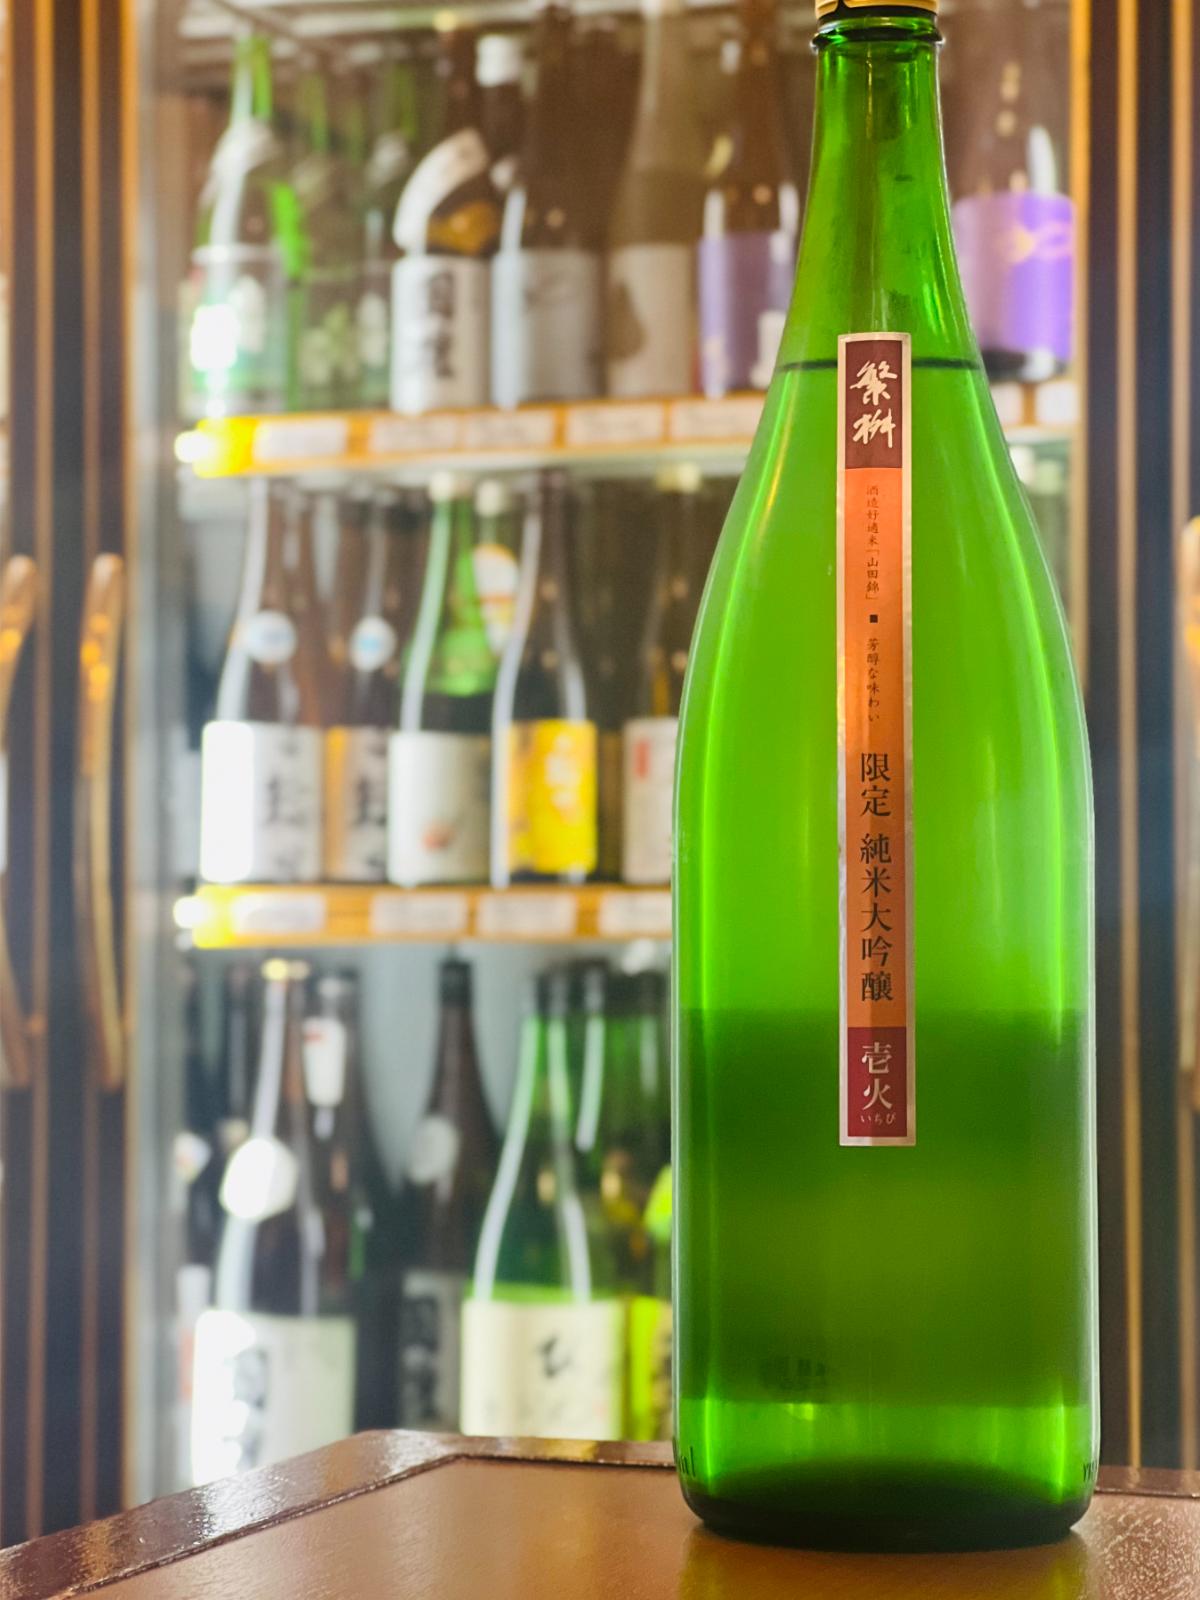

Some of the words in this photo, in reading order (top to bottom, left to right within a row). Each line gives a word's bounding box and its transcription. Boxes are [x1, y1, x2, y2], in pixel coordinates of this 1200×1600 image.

[866, 638, 880, 722] 芳醇な味わい
[860, 752, 892, 818] 限定
[860, 833, 894, 1003] 純米大吟醸
[861, 1041, 894, 1111] 壱火
[859, 1113, 896, 1126] いちび
